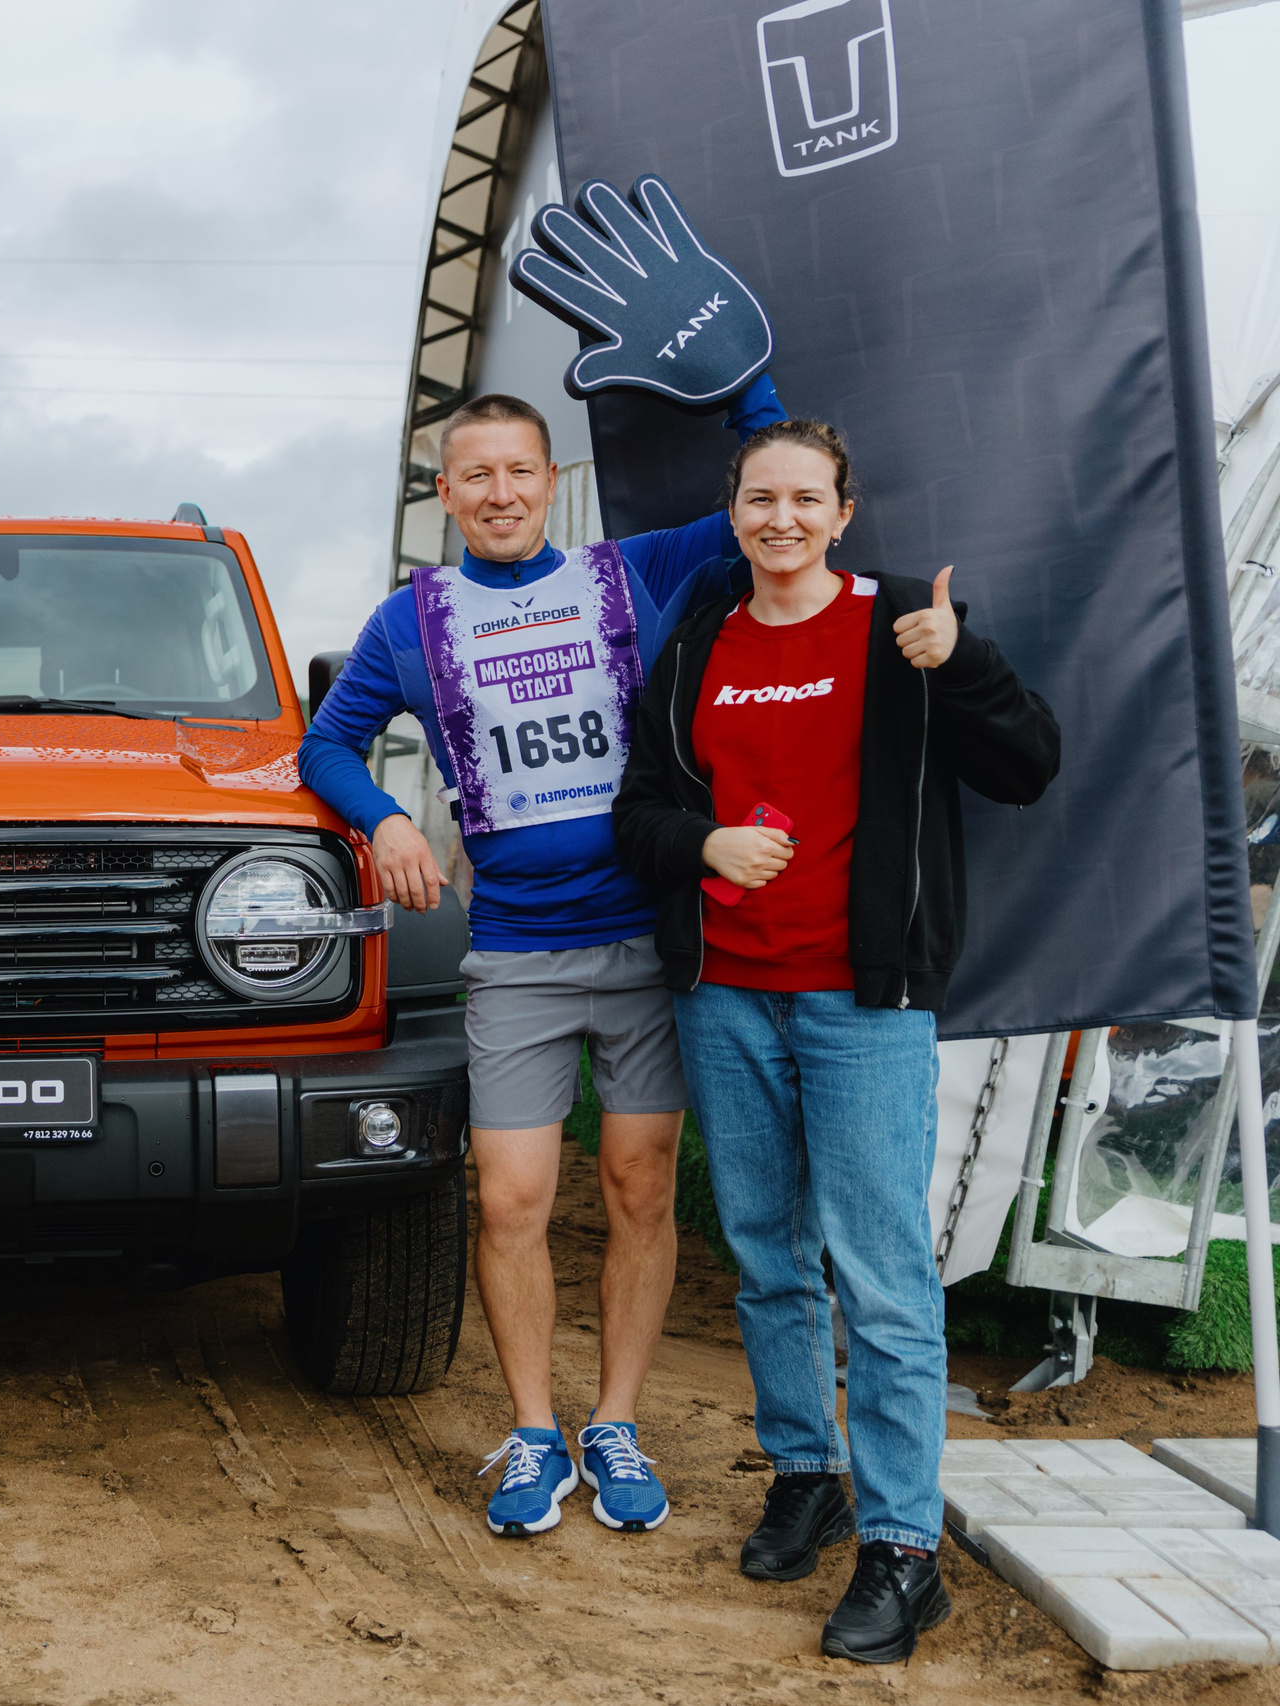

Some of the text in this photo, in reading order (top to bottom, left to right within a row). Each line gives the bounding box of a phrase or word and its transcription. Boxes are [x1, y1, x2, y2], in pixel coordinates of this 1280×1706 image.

[793, 119, 880, 156] TANK
[656, 291, 729, 359] TANK
[473, 605, 580, 635] ГОНКА ГЕРОЕВ
[479, 641, 591, 683] МАССОВЫЙ
[511, 673, 567, 701] СТАРТ
[713, 677, 835, 705] kronos
[489, 710, 609, 774] 1658
[535, 782, 614, 805] ГАЗПРОМБАНК
[23, 1129, 93, 1139] +7 812 329 76 66
